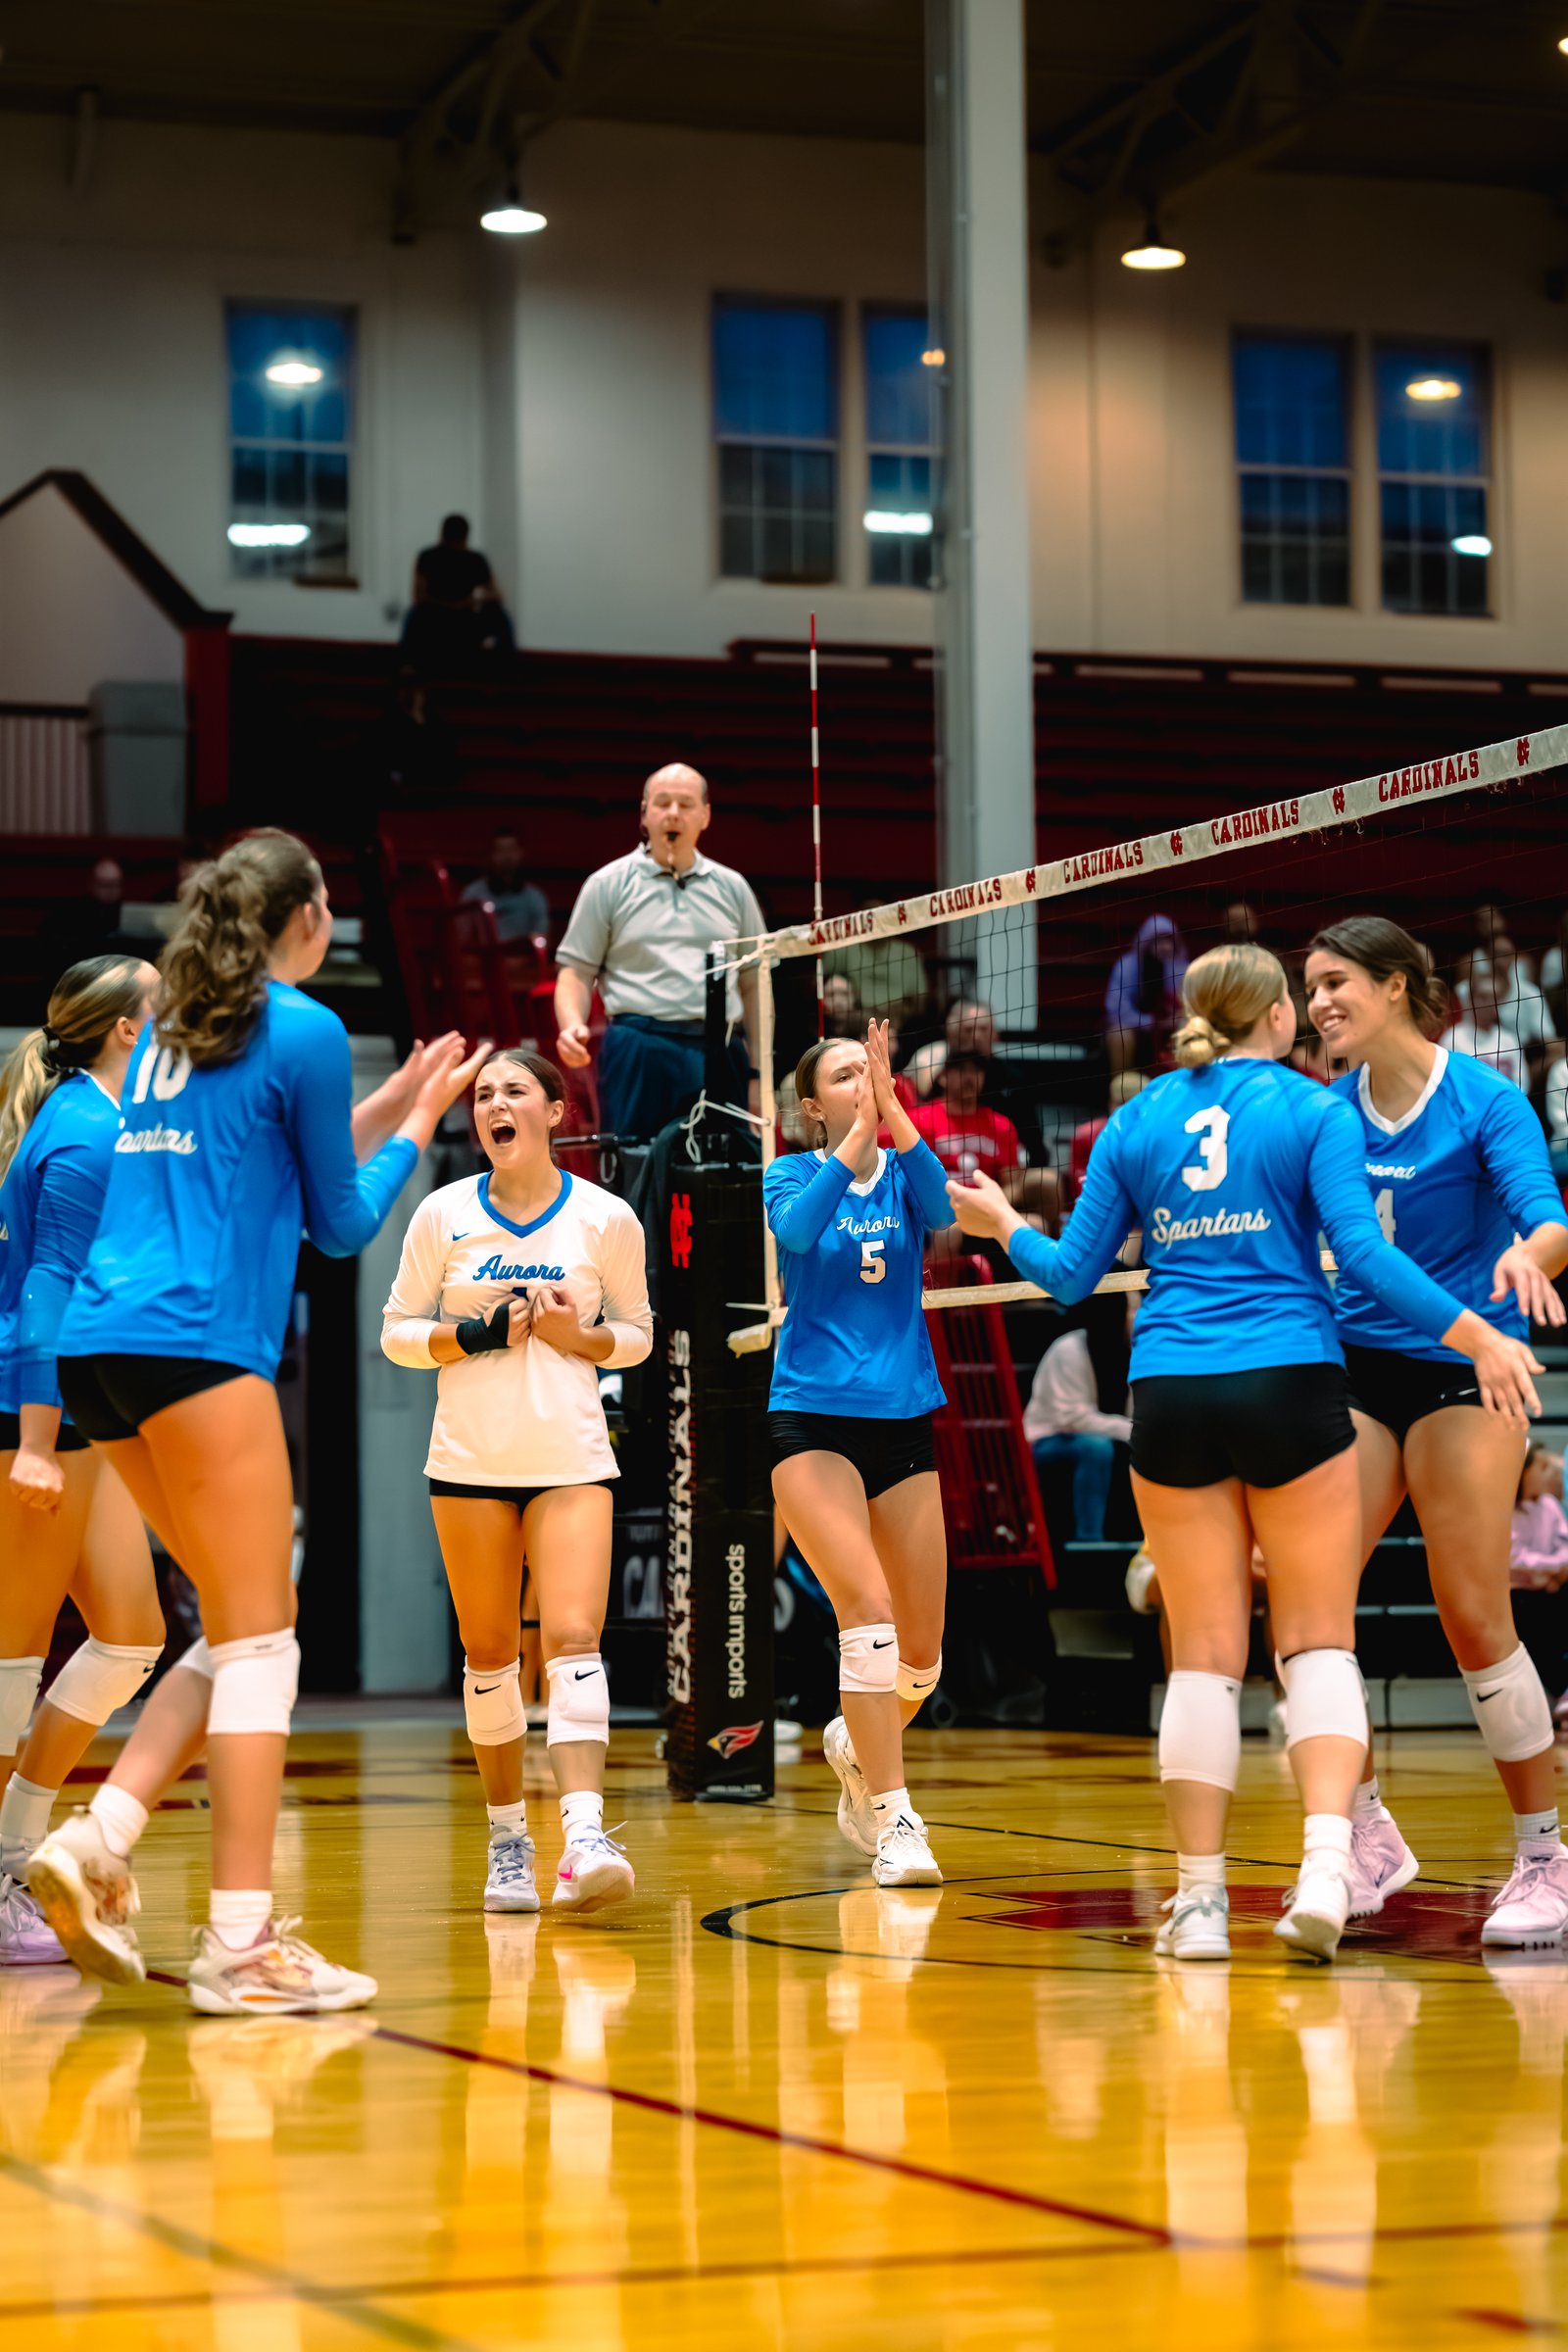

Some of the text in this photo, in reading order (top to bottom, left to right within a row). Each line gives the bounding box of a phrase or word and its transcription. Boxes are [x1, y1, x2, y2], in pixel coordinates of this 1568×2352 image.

[930, 878, 1003, 917] CARDINALS
[1063, 841, 1144, 884] CARDINALS
[1210, 799, 1299, 846] CARDINALS
[1378, 751, 1480, 803] CARDINALS
[1182, 1104, 1231, 1193] 3
[836, 1215, 900, 1235] Aurora
[1152, 1206, 1271, 1250] Spartans
[472, 1254, 565, 1281] Aurora
[859, 1240, 886, 1284] 5
[673, 1329, 691, 1704] CARDINALS
[724, 1544, 748, 1698] sports imports
